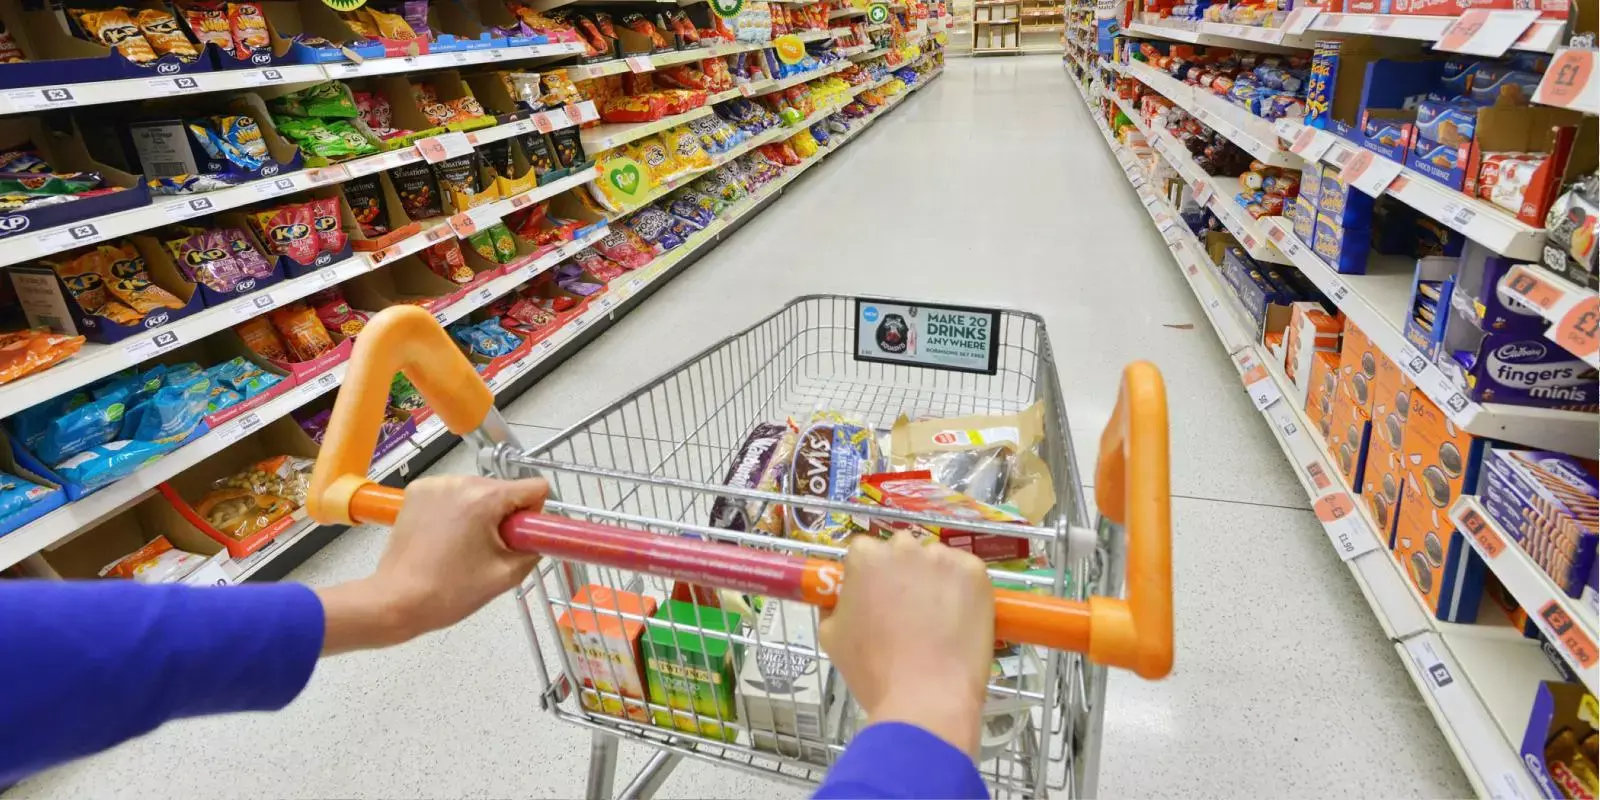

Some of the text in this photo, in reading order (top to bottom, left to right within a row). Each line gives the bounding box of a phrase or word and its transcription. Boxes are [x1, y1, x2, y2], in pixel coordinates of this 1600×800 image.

[255, 54, 271, 63] KP
[160, 64, 178, 73] KP
[1554, 63, 1579, 86] £1
[264, 165, 278, 176] KP
[275, 224, 310, 240] KP
[189, 249, 225, 264] KP
[239, 280, 254, 292] KP
[148, 314, 168, 327] KP
[927, 313, 988, 328] MAKE 20
[927, 323, 987, 340] DRINKS
[927, 337, 986, 350] ANYWHERE
[1498, 344, 1540, 360] Cadbury
[1497, 365, 1573, 386] fingers
[1529, 385, 1587, 401] minis
[1338, 532, 1355, 553] £1.90
